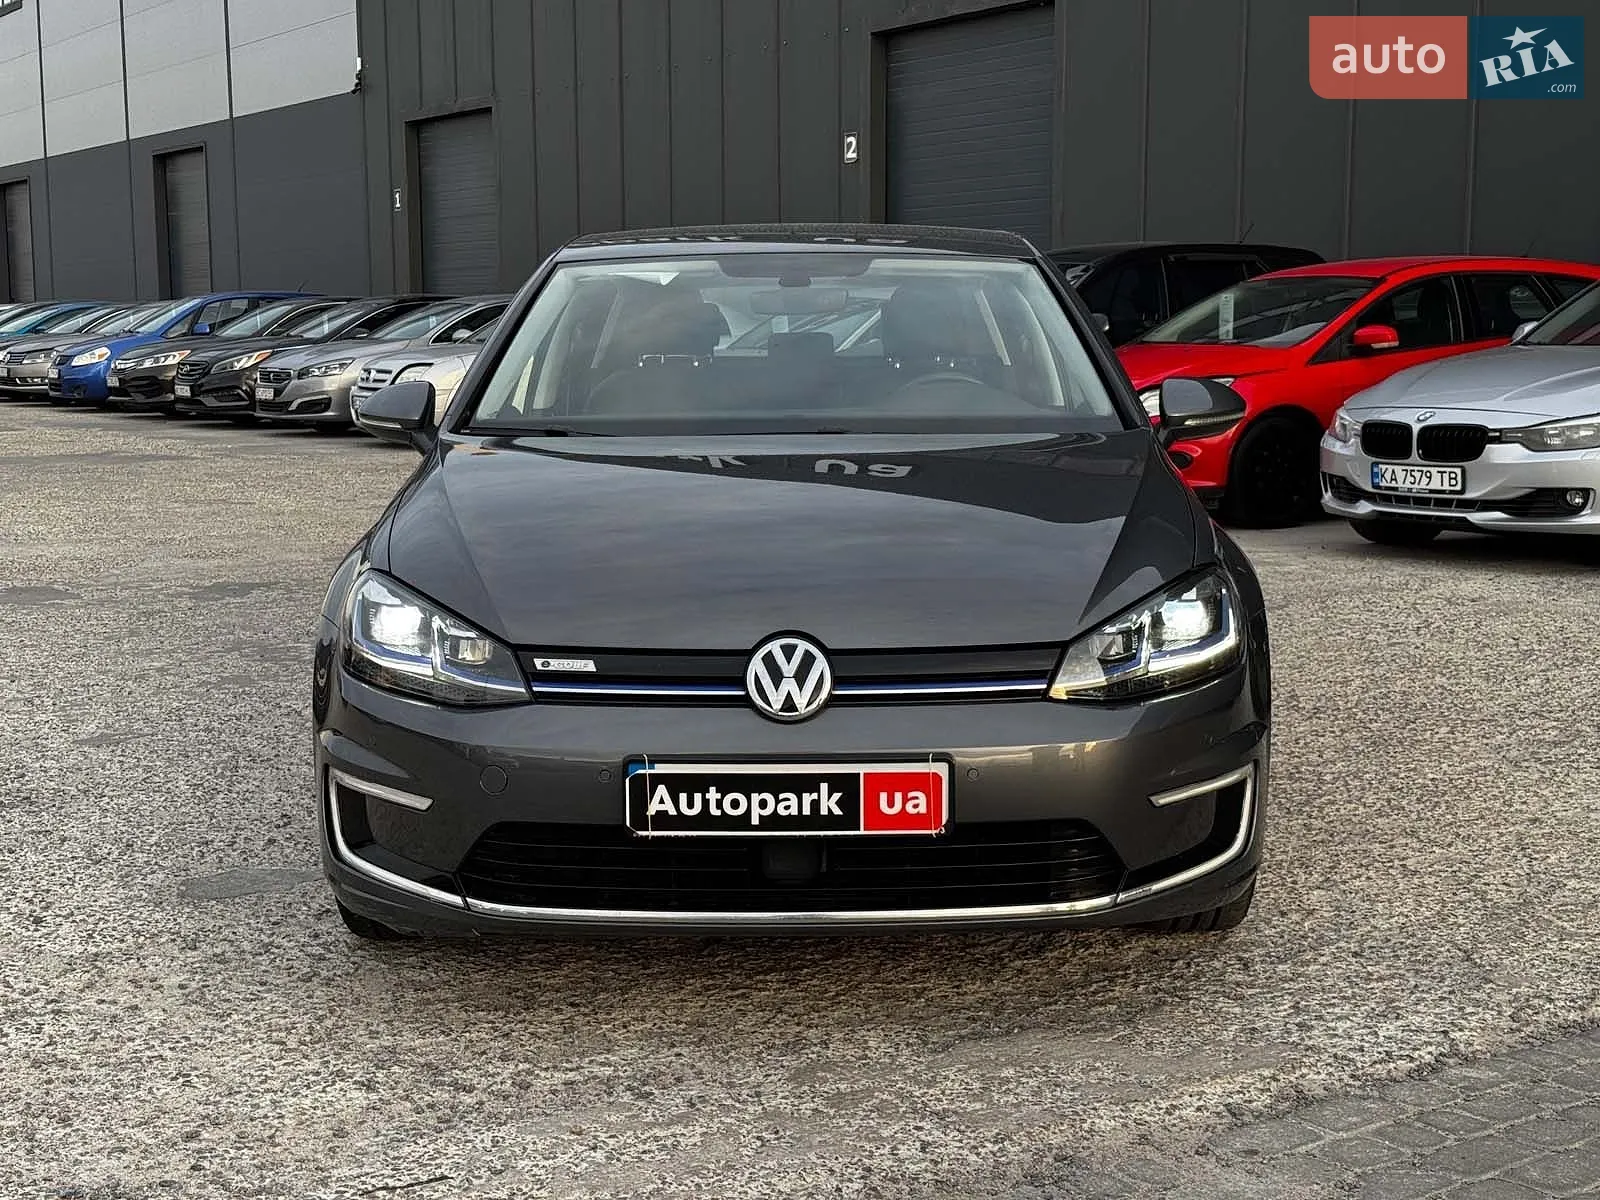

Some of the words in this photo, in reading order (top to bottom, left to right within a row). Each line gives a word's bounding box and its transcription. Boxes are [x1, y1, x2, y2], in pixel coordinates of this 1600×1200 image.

[846, 136, 857, 158] 2
[395, 192, 401, 208] 1
[1380, 467, 1398, 484] KA
[1401, 469, 1432, 486] 7579
[1437, 471, 1458, 487] TB
[648, 783, 843, 825] Autopark
[879, 791, 928, 815] ua
